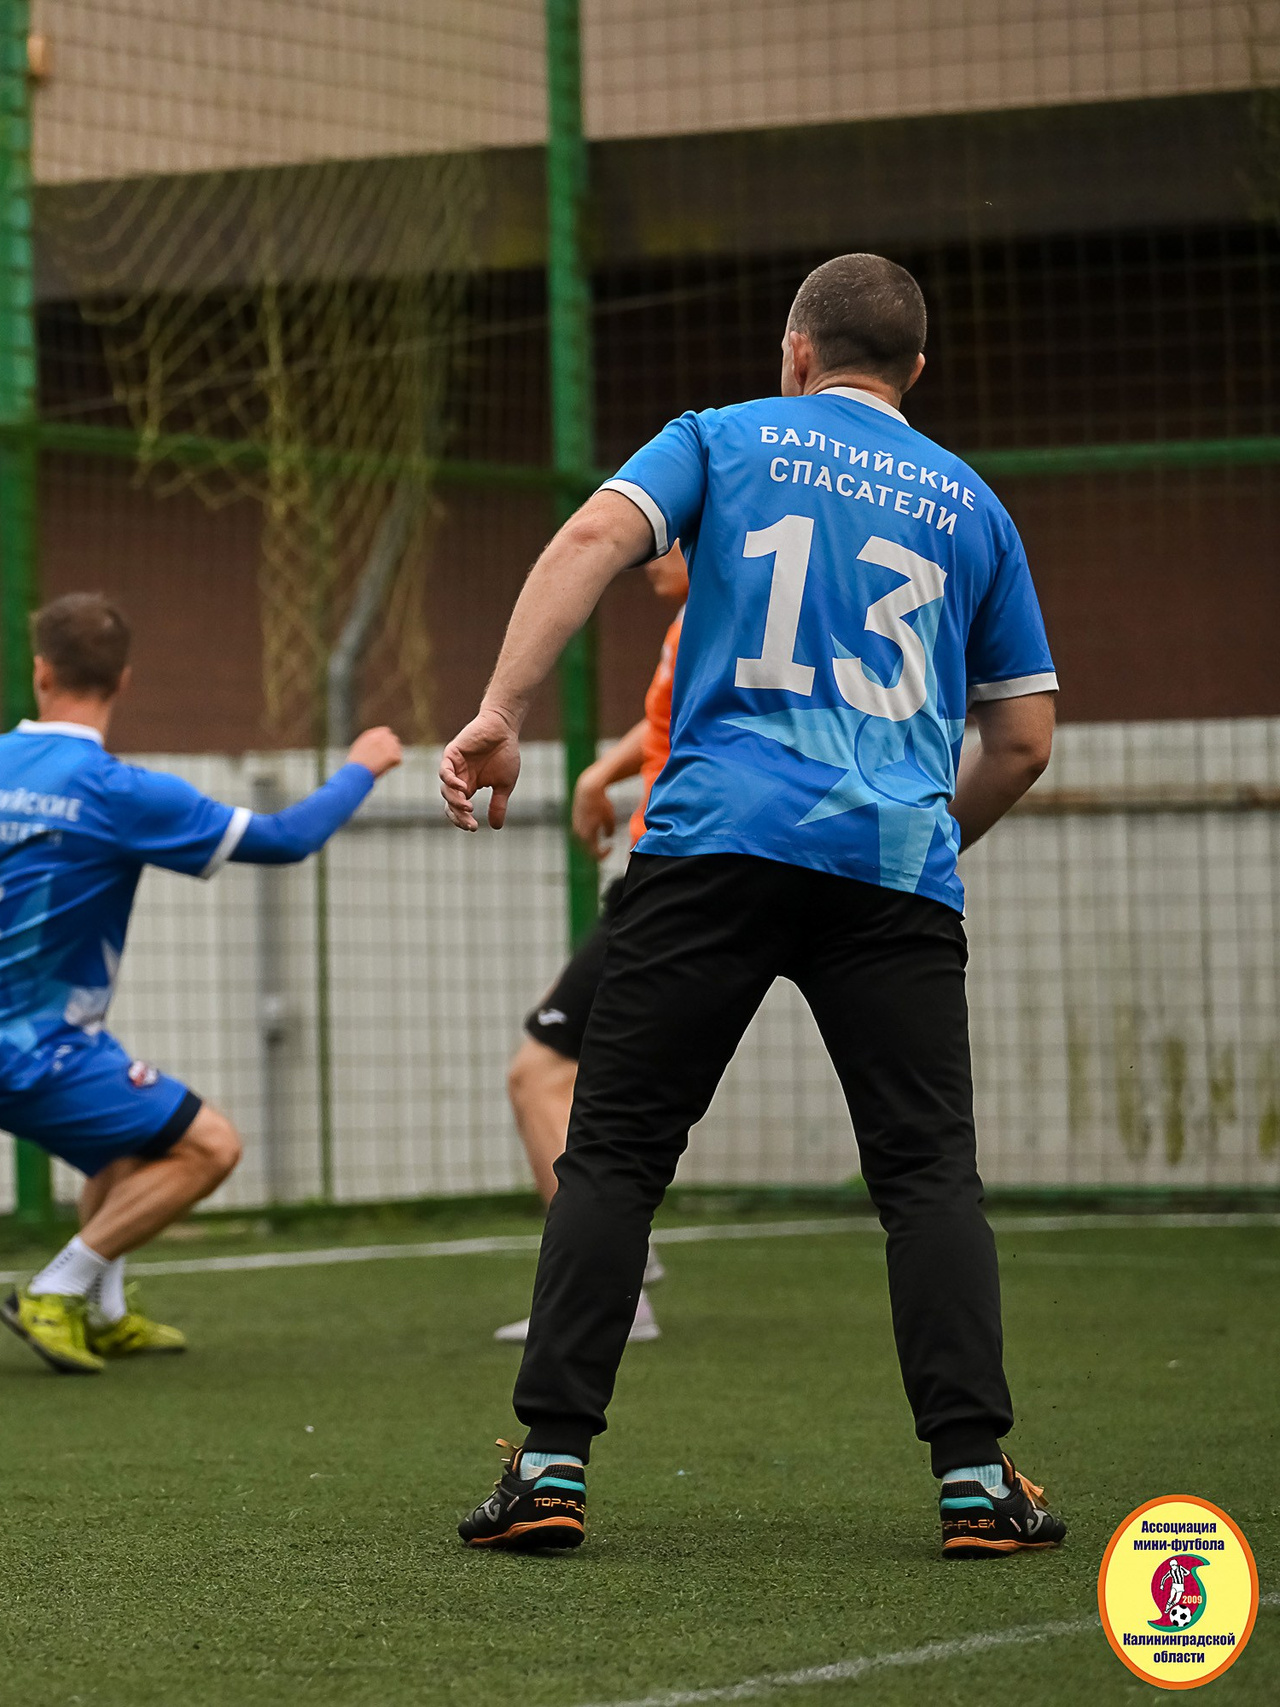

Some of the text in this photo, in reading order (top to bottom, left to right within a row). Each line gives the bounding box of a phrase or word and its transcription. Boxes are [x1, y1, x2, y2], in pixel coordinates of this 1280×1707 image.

[759, 426, 976, 511] БАЛТИЙСКИЕ
[770, 456, 958, 536] СПАСАТЕЛИ
[734, 514, 948, 722] 13
[941, 1518, 996, 1530] P-FLEX
